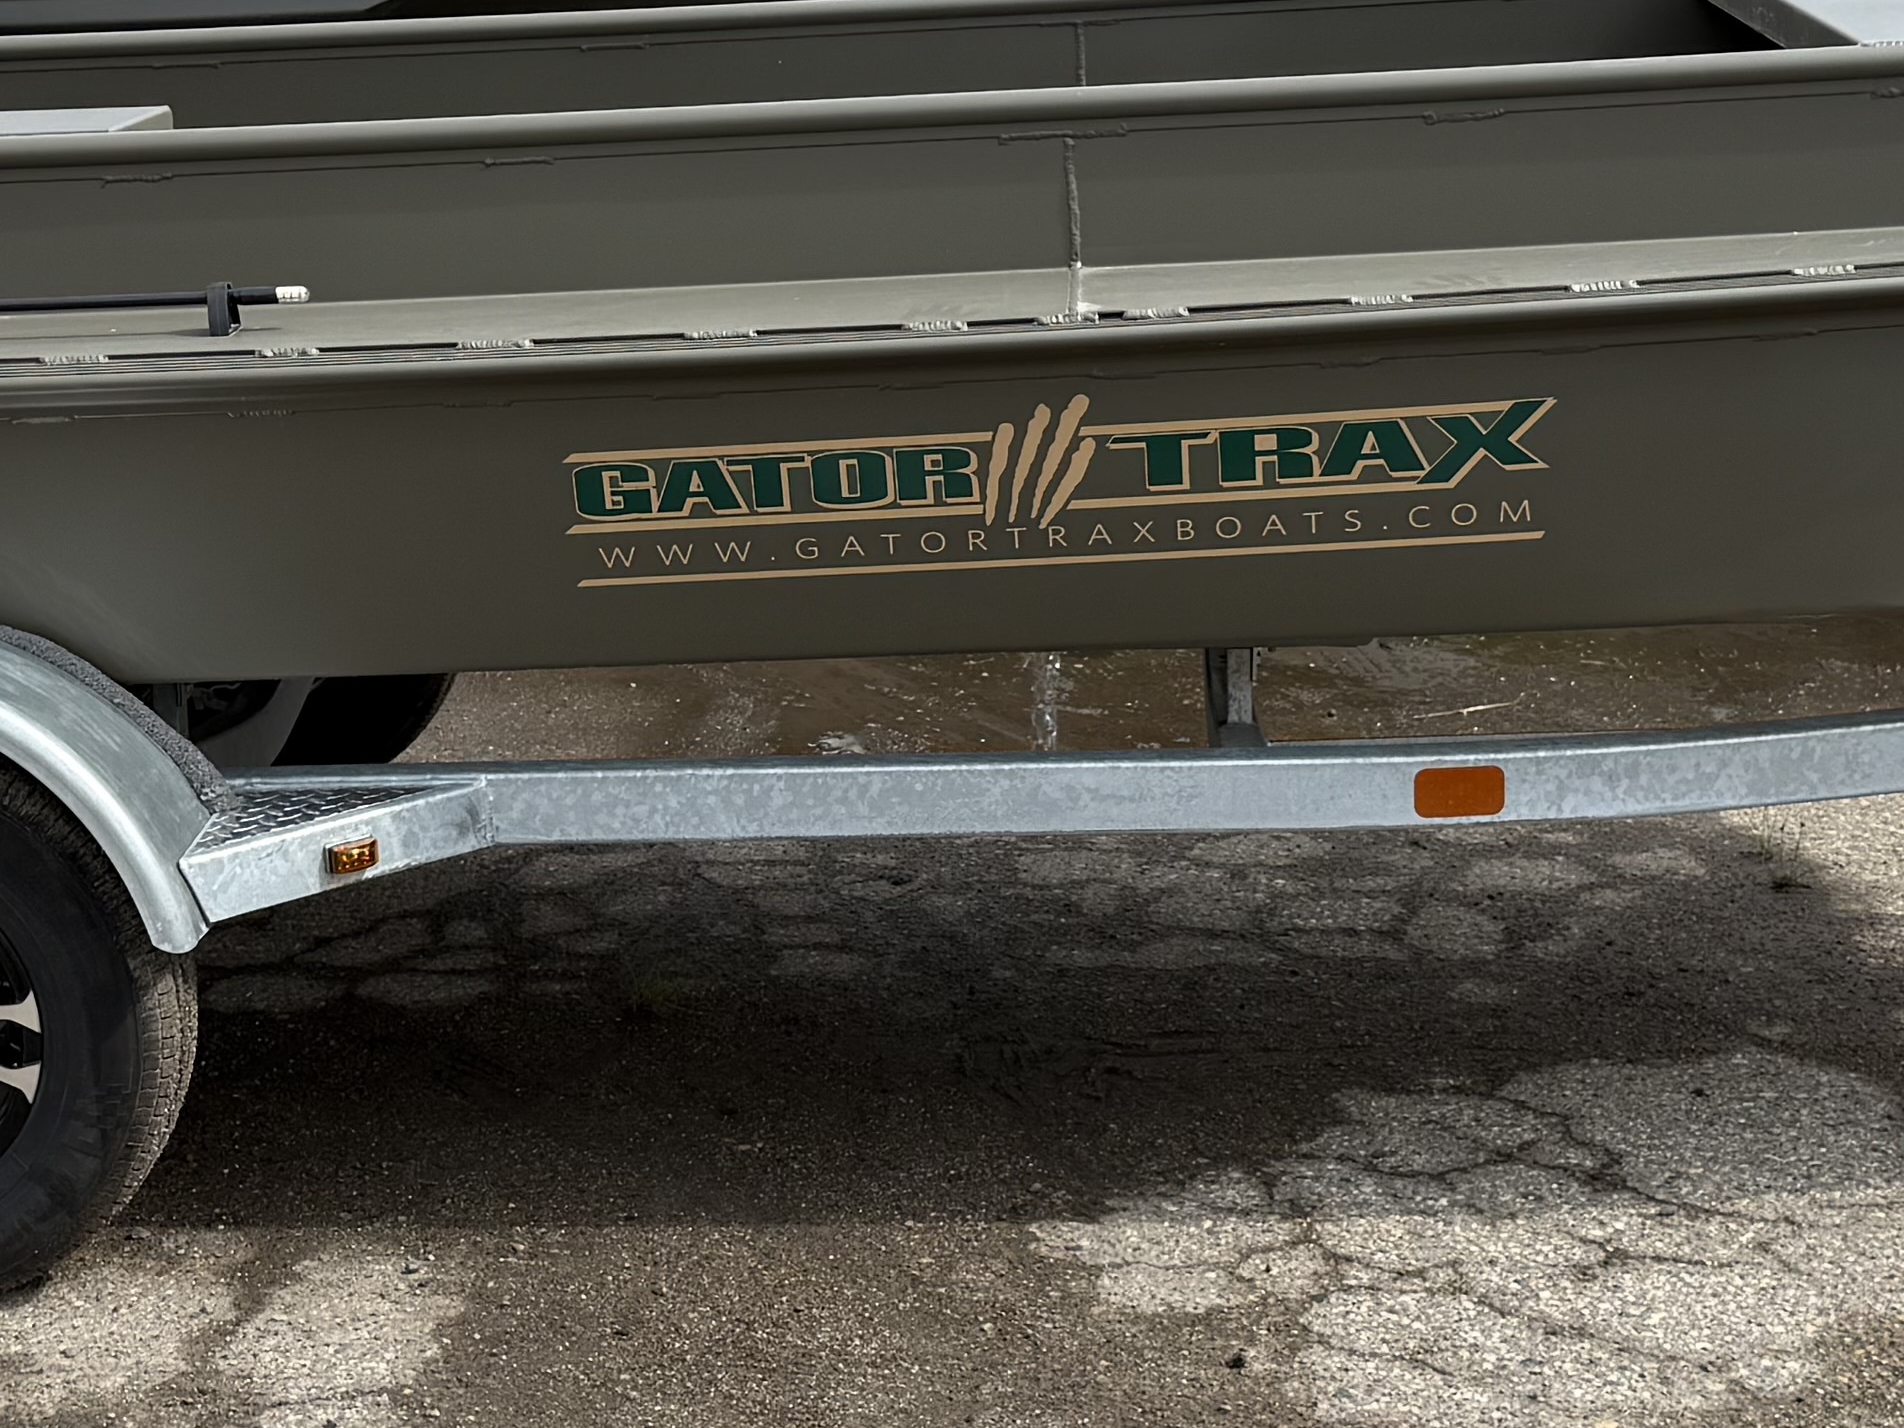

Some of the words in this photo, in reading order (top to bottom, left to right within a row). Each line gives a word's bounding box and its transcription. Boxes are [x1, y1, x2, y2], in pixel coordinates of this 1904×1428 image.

[572, 446, 981, 521] GATOR
[1105, 397, 1557, 491] TRAX
[598, 499, 1532, 568] WWW.GATORTRAXBOATS.COM
